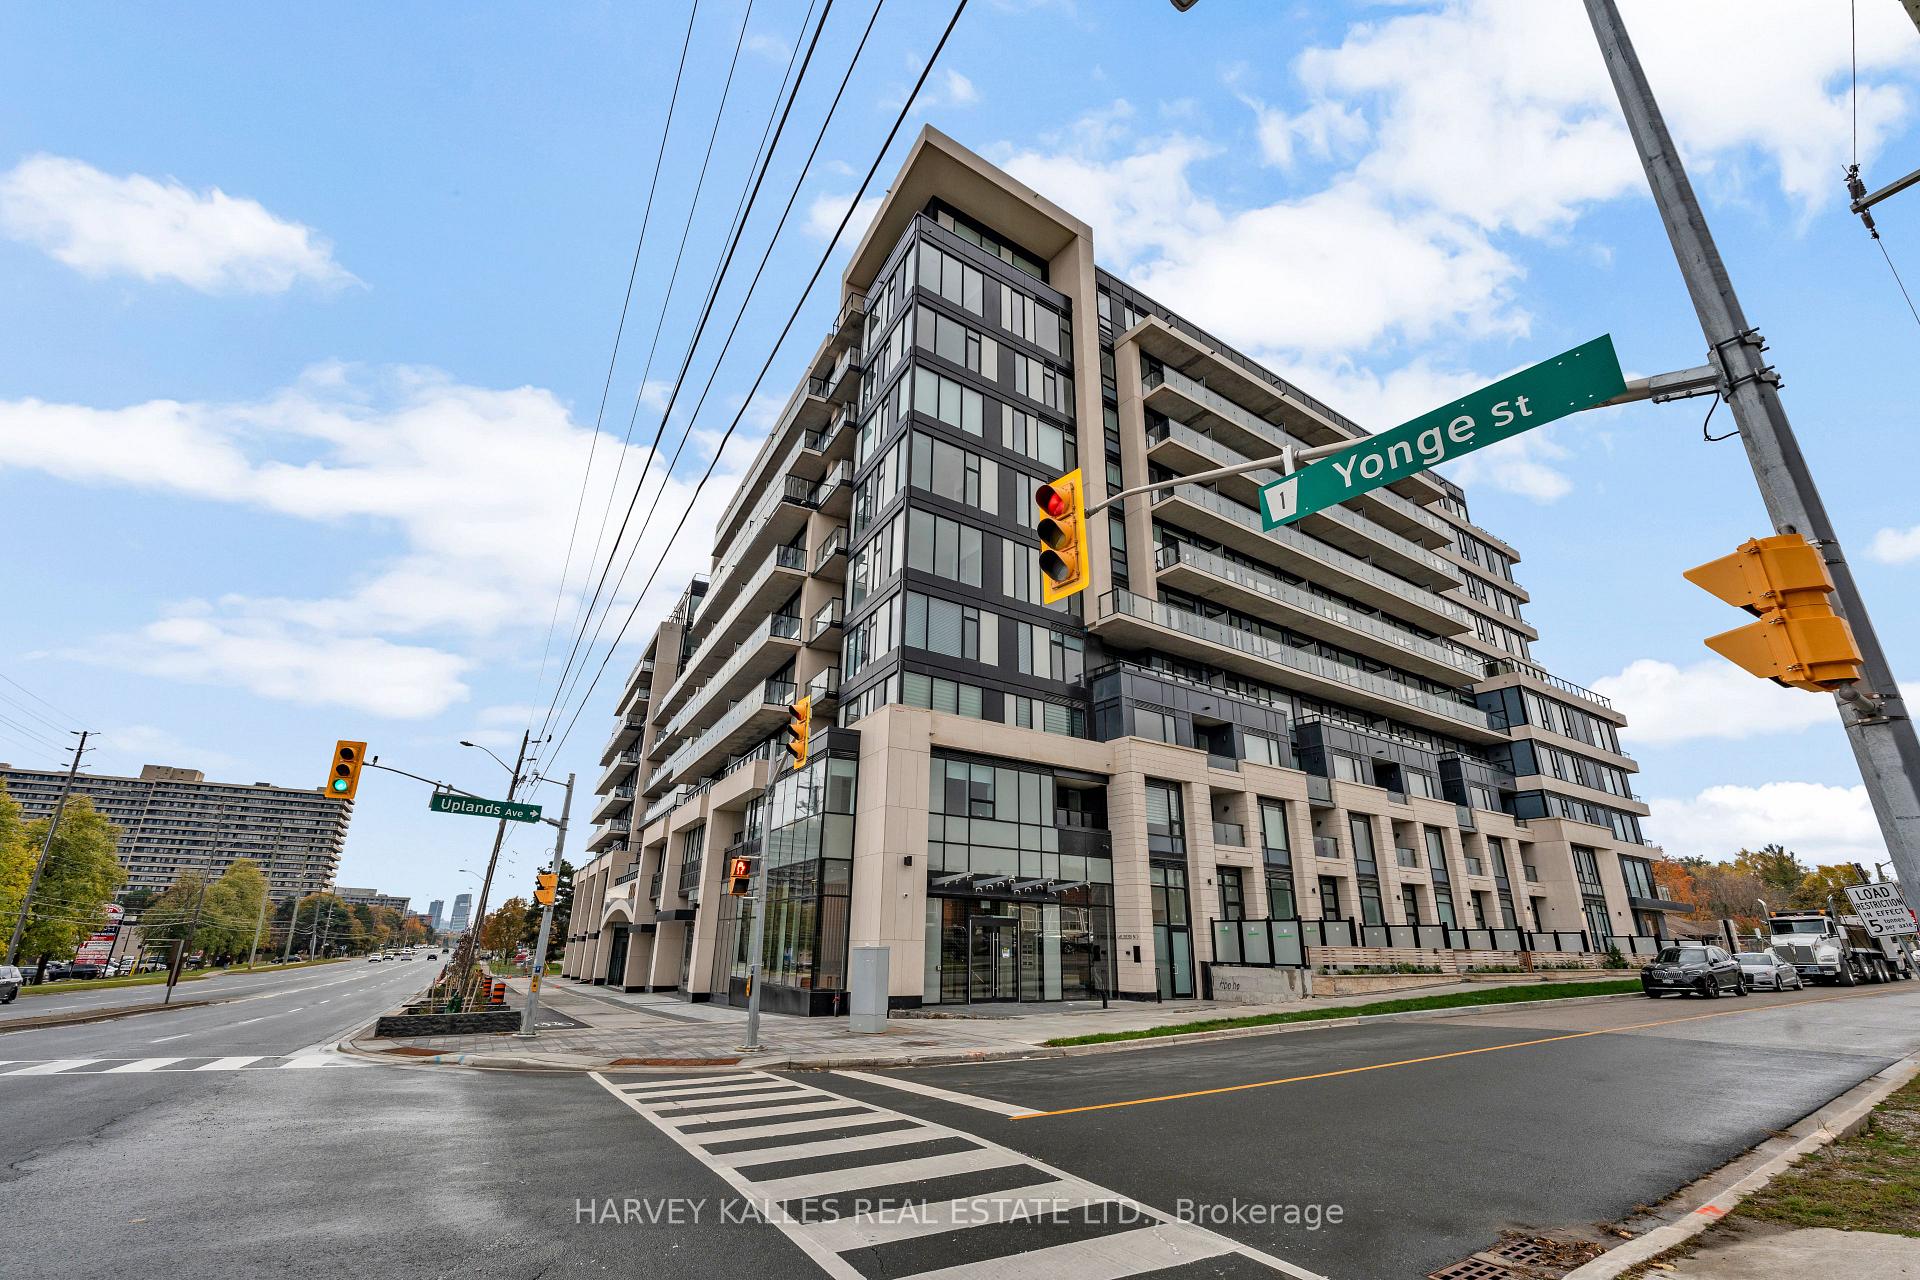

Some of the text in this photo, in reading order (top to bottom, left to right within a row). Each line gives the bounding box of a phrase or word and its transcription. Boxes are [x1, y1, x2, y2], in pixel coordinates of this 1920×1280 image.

[1278, 395, 1534, 510] 1 Yonge St
[441, 798, 524, 818] Uplands Ave
[1855, 887, 1890, 901] LOAD
[1855, 898, 1904, 911] RESTRICTION
[1863, 908, 1905, 919] IN EFFECT
[1868, 919, 1884, 933] 5
